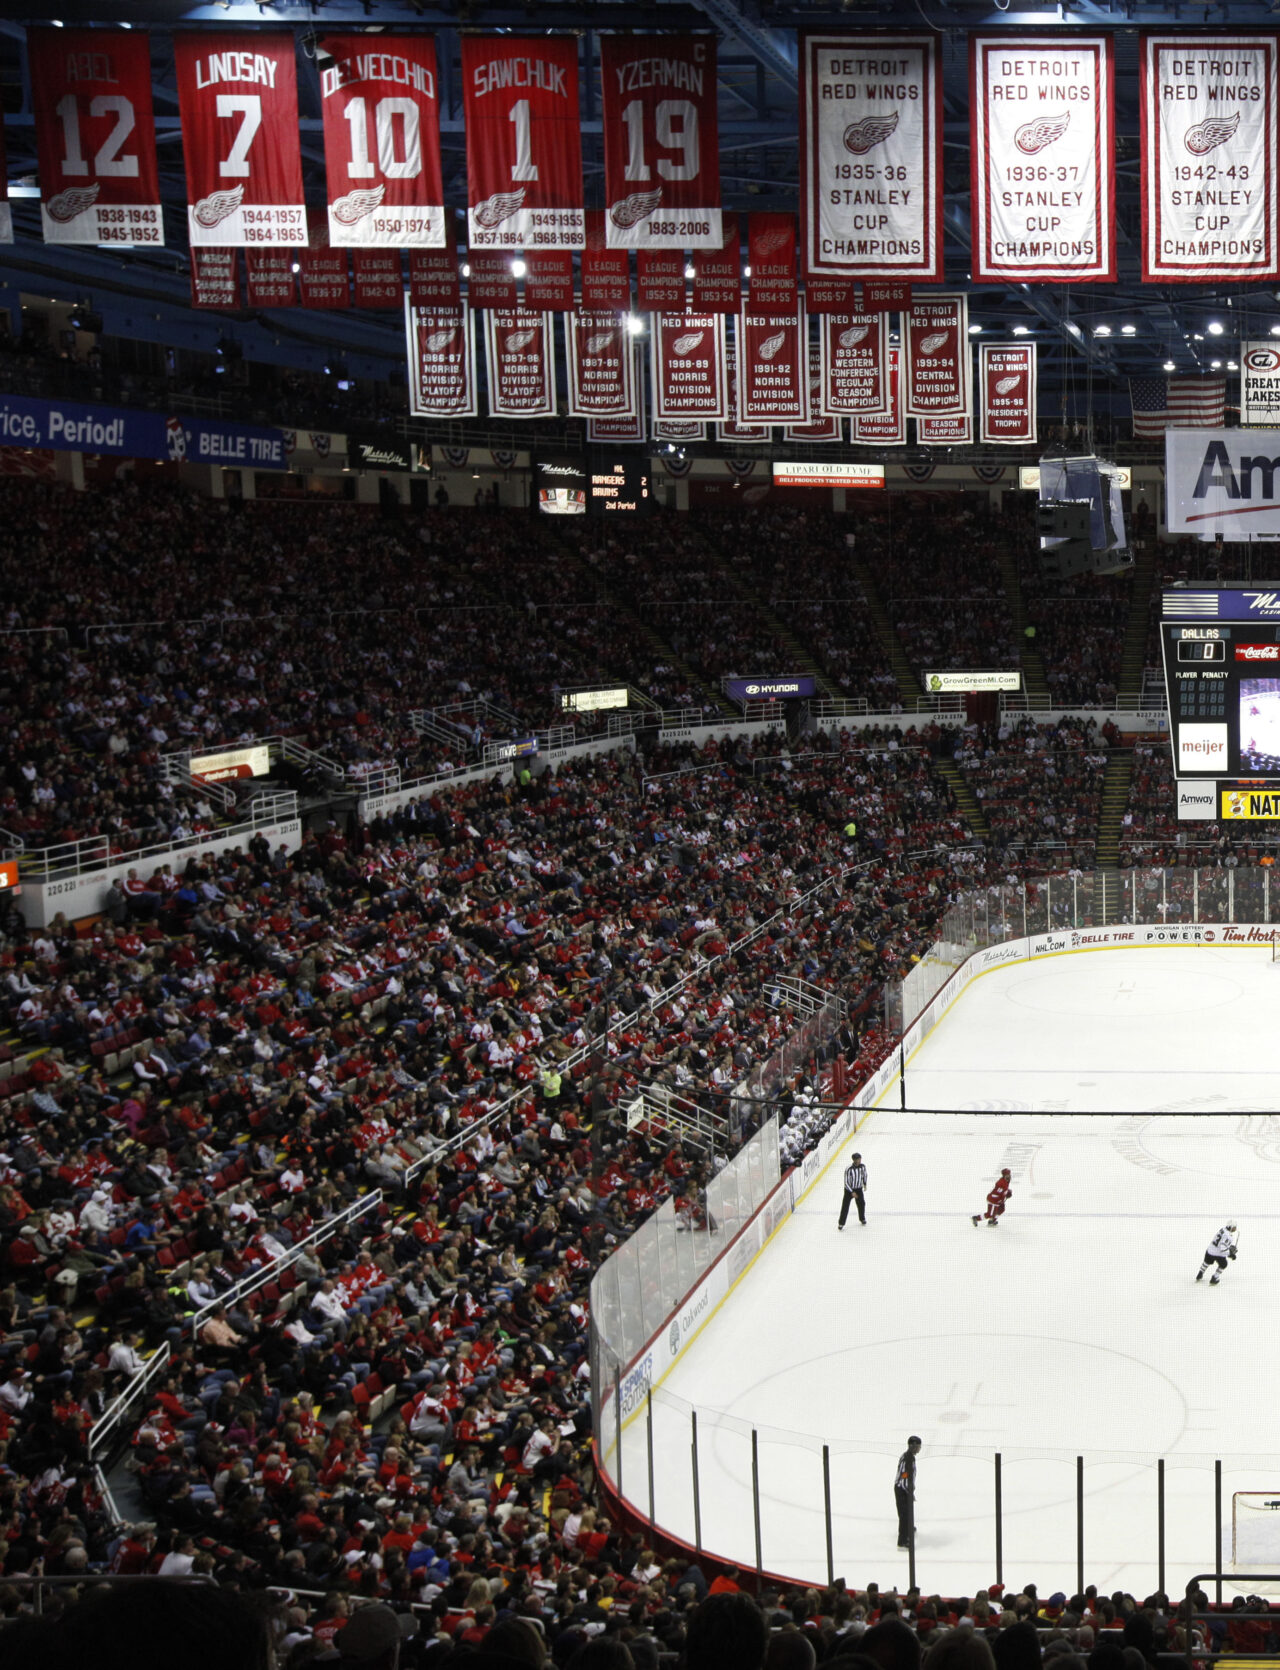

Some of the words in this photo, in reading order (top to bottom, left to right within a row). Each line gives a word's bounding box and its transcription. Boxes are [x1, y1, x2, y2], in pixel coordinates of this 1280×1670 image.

[694, 42, 706, 62] C
[196, 52, 277, 89] LINDSAY
[831, 60, 909, 76] DETROIT
[1001, 61, 1080, 76] DETROIT
[321, 55, 434, 98] DELVECCHIO
[474, 55, 567, 98] SAWCHUK
[616, 58, 703, 96] YZERMAN
[823, 85, 856, 100] RED
[867, 85, 919, 100] WINGS
[993, 85, 1028, 100] RED
[1038, 85, 1090, 100] WINGS
[56, 97, 138, 177] 12
[216, 95, 261, 177] 7
[343, 98, 422, 178] 10
[509, 100, 538, 181] 1
[622, 100, 698, 181] 19
[834, 165, 907, 180] 1935-36
[1006, 166, 1079, 182] 1936-37
[831, 190, 911, 206] STANLEY
[1002, 191, 1083, 207] STANLEY
[96, 210, 157, 223] 1938-1943
[242, 210, 303, 224] 1944-1957
[531, 214, 582, 226] 1949-1955
[854, 216, 888, 230] CUP
[373, 219, 432, 232] 1950-1974
[648, 221, 710, 235] 1983-2006
[1026, 217, 1061, 232] CUP
[99, 227, 161, 241] 1945-1952
[244, 229, 305, 242] 1964-1965
[473, 233, 524, 245] 1957-1964
[533, 232, 584, 245] 1968-1969
[823, 240, 921, 255] CHAMPIONS
[994, 241, 1094, 257] CHAMPIONS
[914, 306, 952, 315] DETROIT
[911, 318, 930, 327] RED
[933, 317, 958, 327] WINGS
[916, 359, 953, 368] 1993-94
[916, 372, 954, 380] CENTRAL
[1245, 378, 1280, 388] GREAT
[916, 384, 956, 393] DIVISION
[913, 395, 959, 405] CHAMPIONS
[1245, 391, 1280, 401] LAKES
[49, 412, 124, 446] Period!
[200, 433, 245, 457] BELLE
[250, 438, 281, 460] TIRE
[786, 466, 819, 474] LIPARI
[1182, 629, 1219, 639] DALLAS
[1204, 644, 1213, 659] 0
[761, 684, 798, 693] HYUNDAI
[1182, 740, 1224, 755] meijer
[1181, 794, 1213, 804] Amway
[48, 885, 62, 896] 220
[1082, 935, 1110, 943] BELLE
[1113, 932, 1134, 941] TIRE
[1144, 932, 1201, 942] POWER
[1222, 927, 1245, 941] Tim
[1035, 941, 1065, 953] NHL.COM
